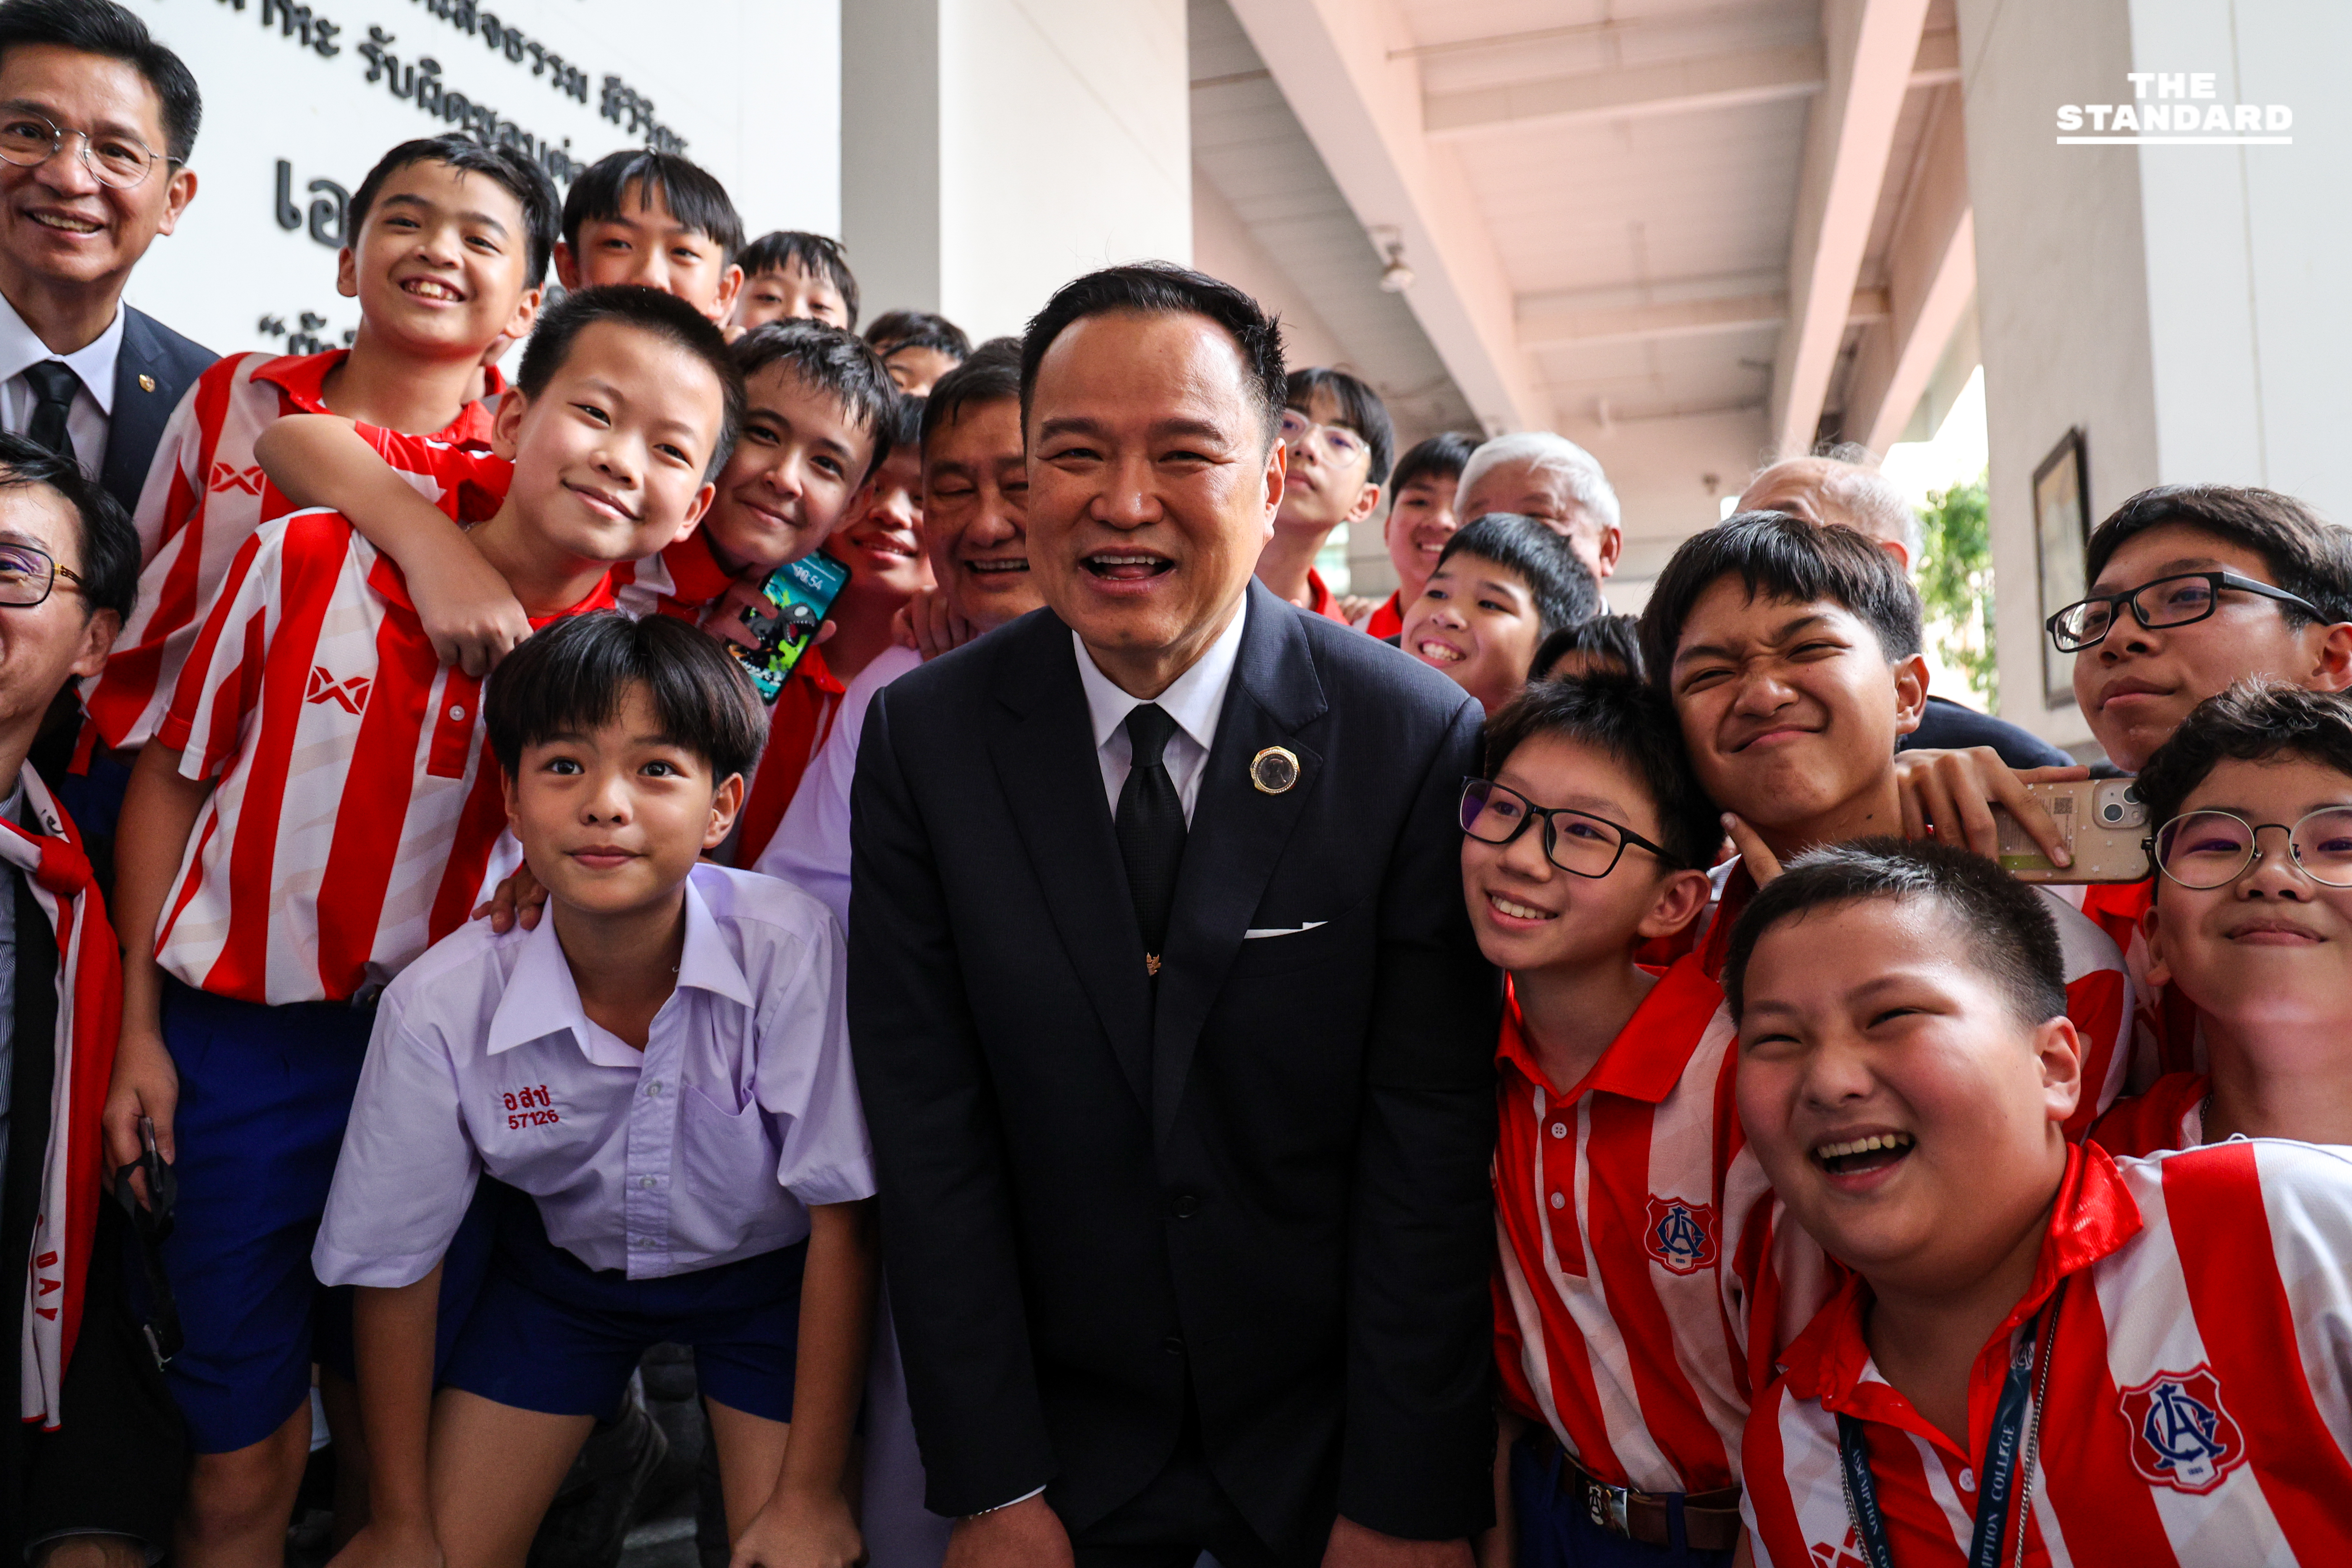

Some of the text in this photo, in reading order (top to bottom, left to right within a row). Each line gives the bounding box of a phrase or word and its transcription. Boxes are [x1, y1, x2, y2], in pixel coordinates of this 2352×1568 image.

[508, 1109, 559, 1129] 57126
[35, 1250, 61, 1321] DAY
[1851, 1448, 1890, 1568] ASSUMPTION CO
